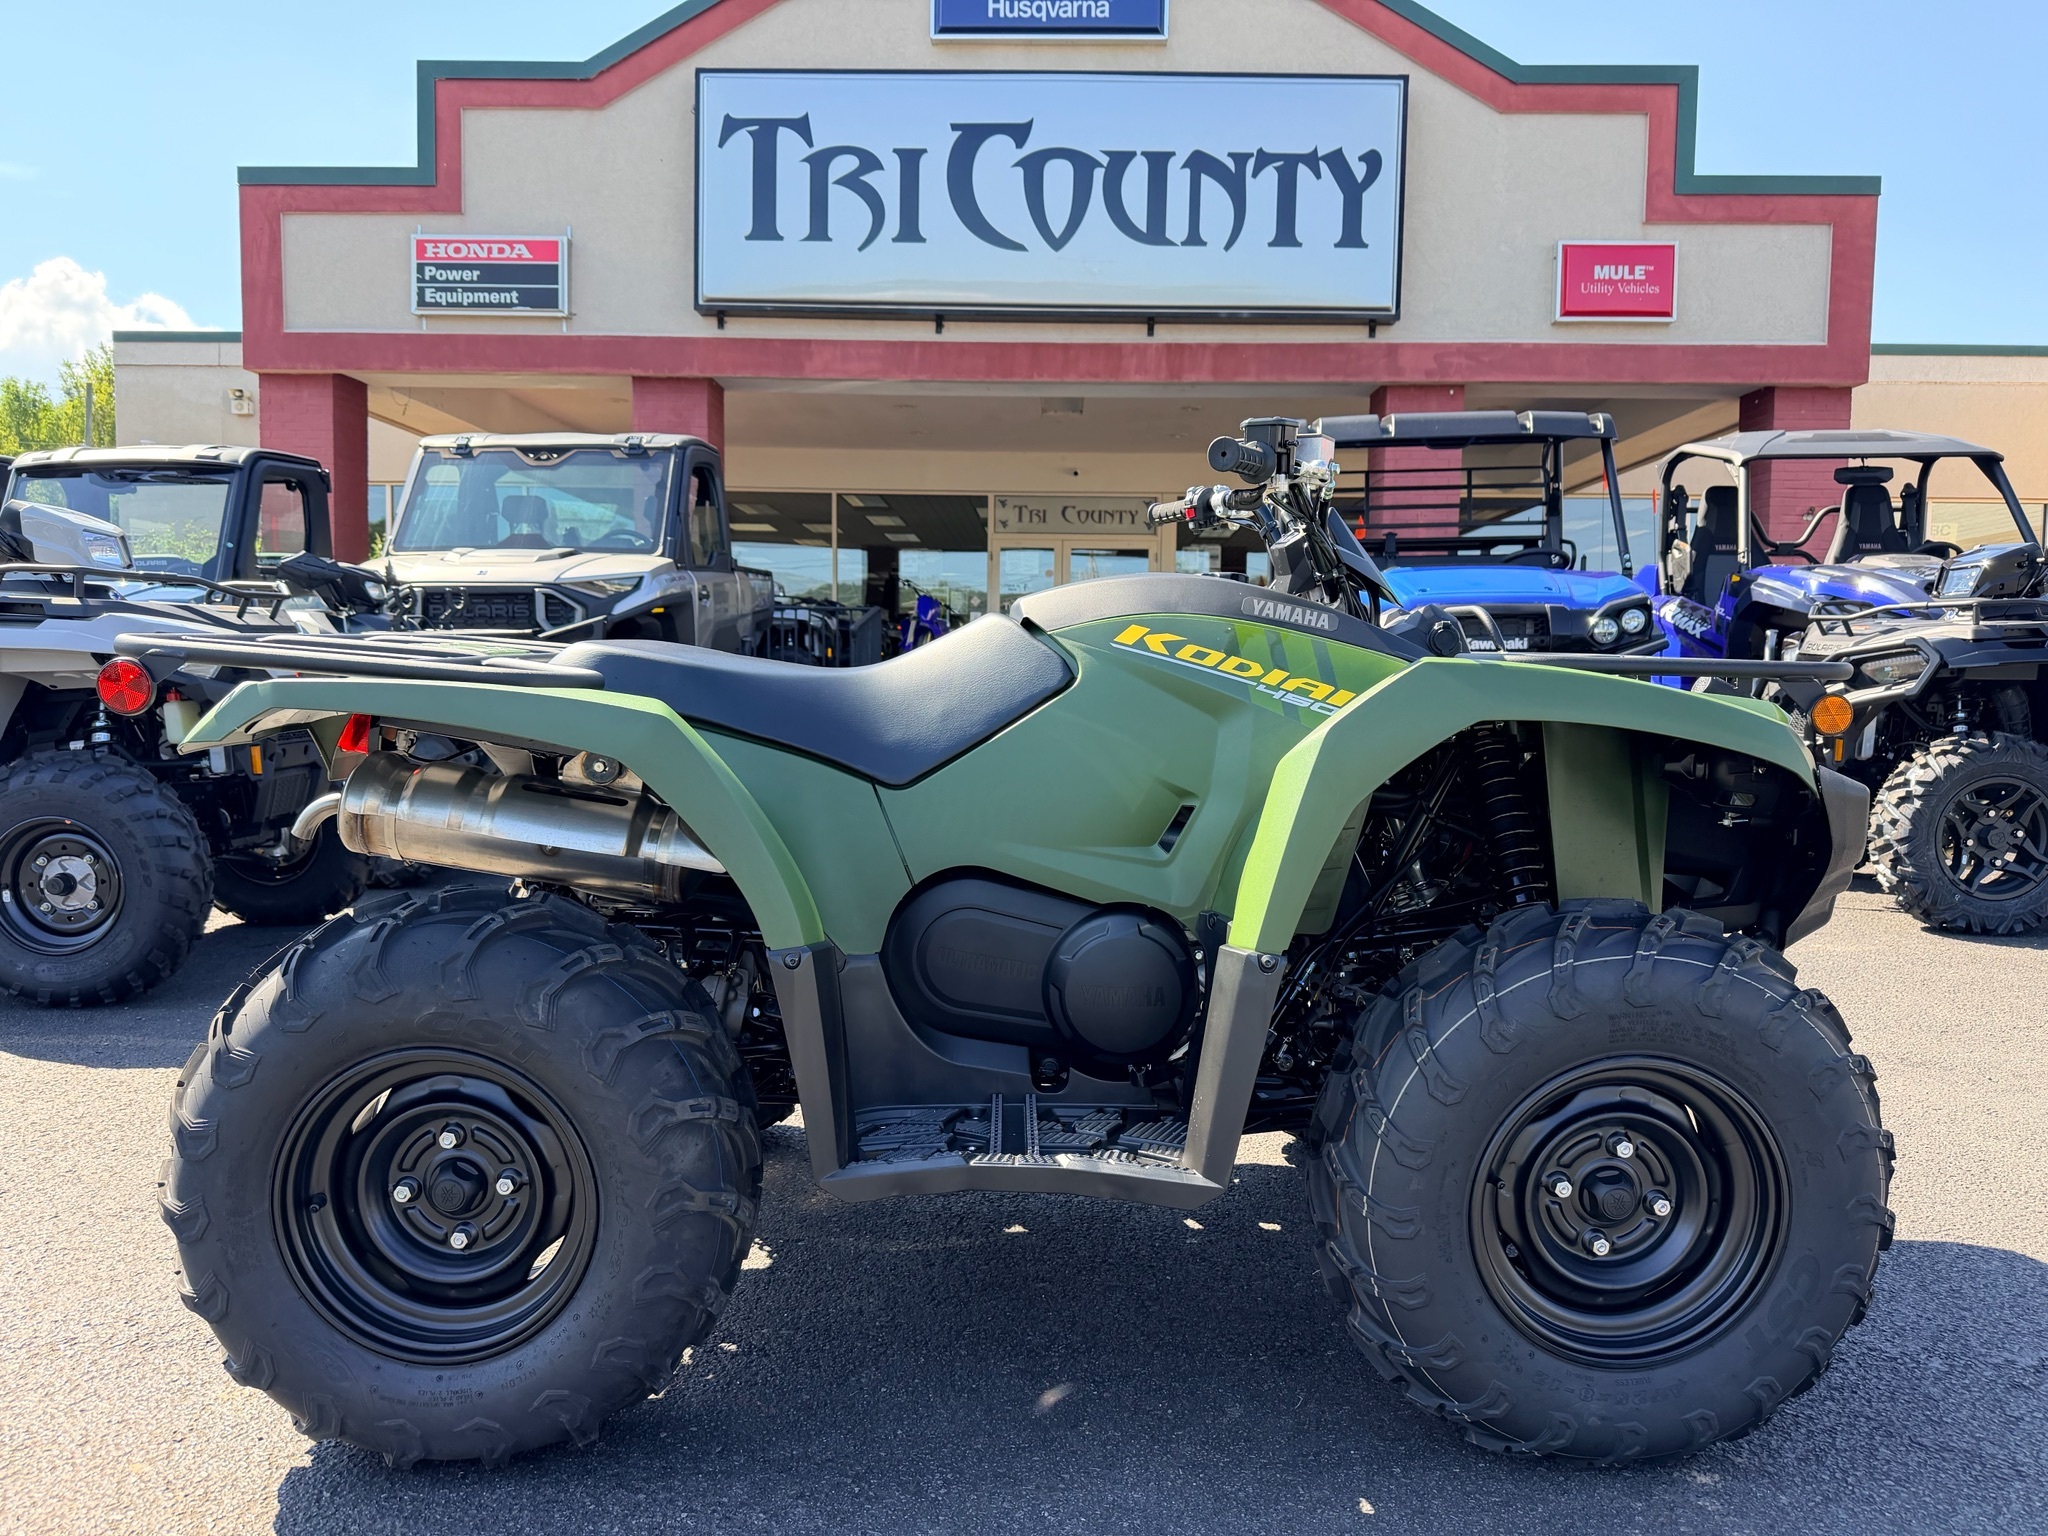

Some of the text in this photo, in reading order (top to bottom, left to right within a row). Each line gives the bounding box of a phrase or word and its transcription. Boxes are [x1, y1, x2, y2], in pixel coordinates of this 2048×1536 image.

[987, 0, 1110, 22] Husqvarna
[718, 112, 1382, 253] TRI COUNTY
[424, 243, 533, 258] HONDA
[424, 266, 480, 281] Power
[424, 288, 519, 306] Equipment
[1581, 282, 1660, 296] Utility Vehicles
[1013, 504, 1139, 525] TRI COUNTY
[1715, 543, 1738, 551] YAMAHA
[1252, 599, 1330, 630] YAMAHA
[1256, 684, 1342, 717] 450
[1081, 985, 1167, 1008] YAMAHA
[413, 1010, 552, 1064] CST
